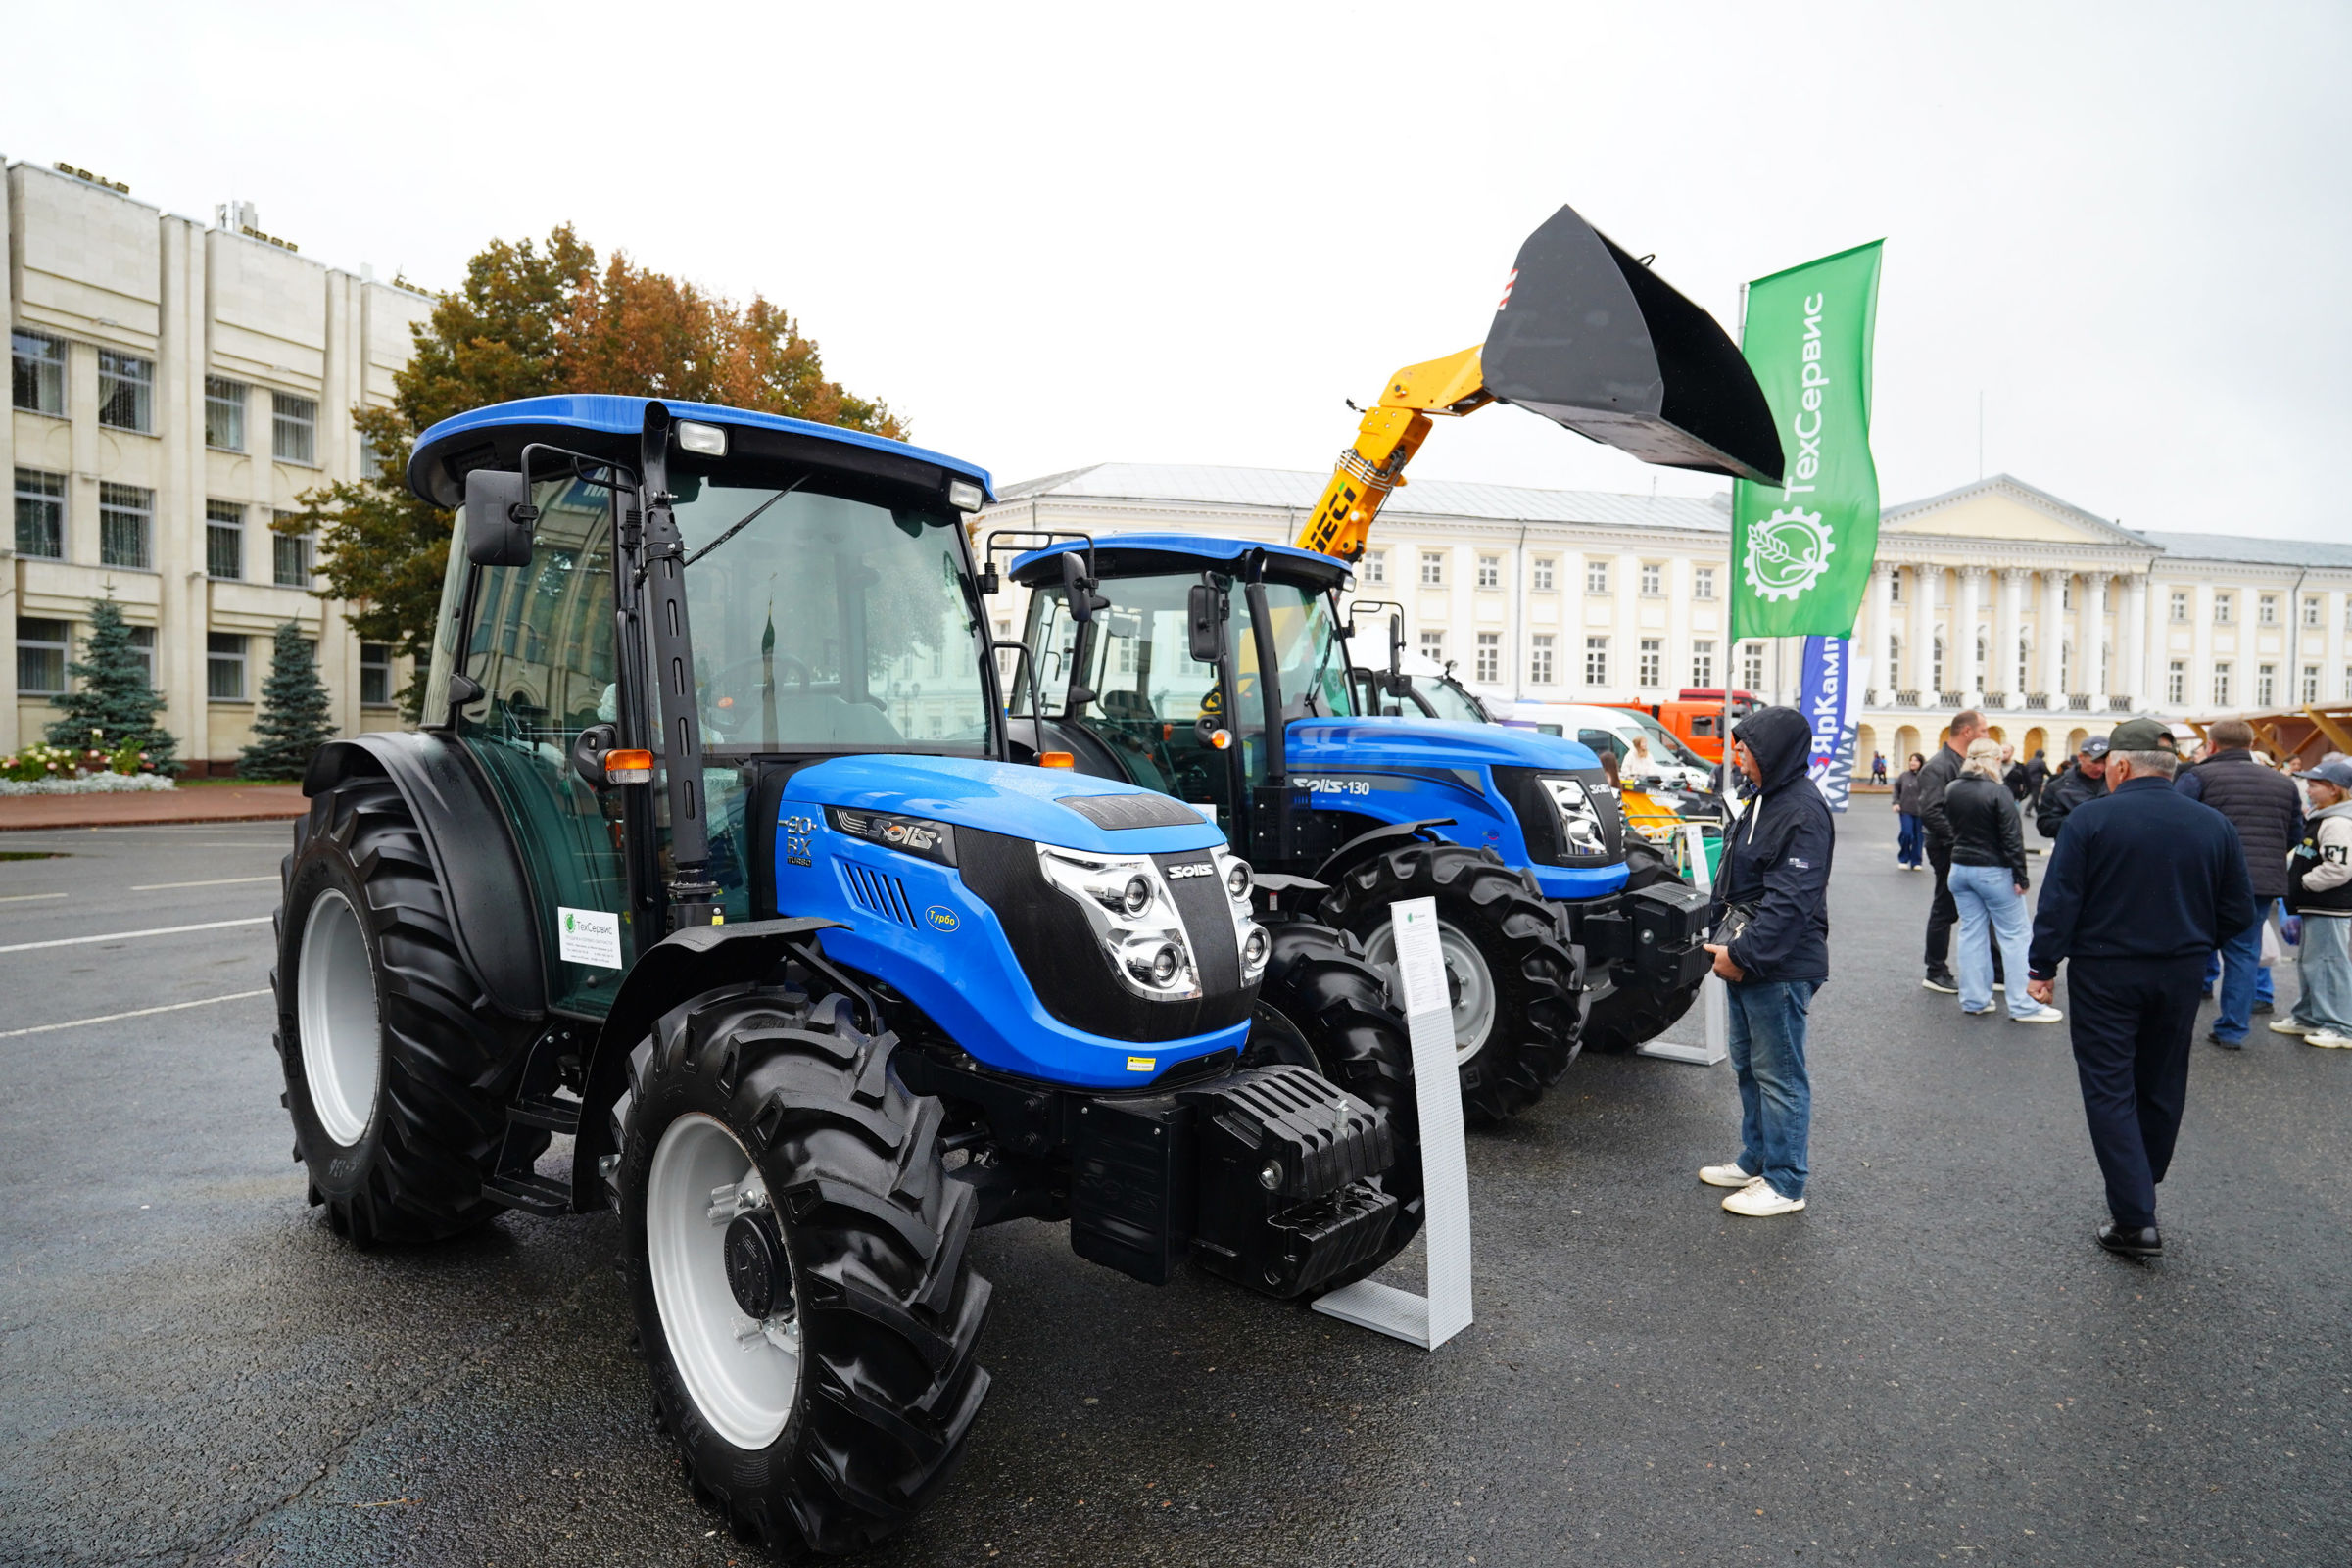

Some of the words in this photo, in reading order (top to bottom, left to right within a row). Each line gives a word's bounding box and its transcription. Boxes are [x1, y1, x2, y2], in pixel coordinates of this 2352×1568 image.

[1784, 292, 1830, 502] ТехСервис
[1304, 487, 1357, 554] IECI
[787, 836, 812, 857] RX
[2324, 845, 2348, 865] F1
[787, 857, 812, 867] TURBO
[577, 921, 613, 935] ТехСервис
[930, 910, 955, 926] Турбо
